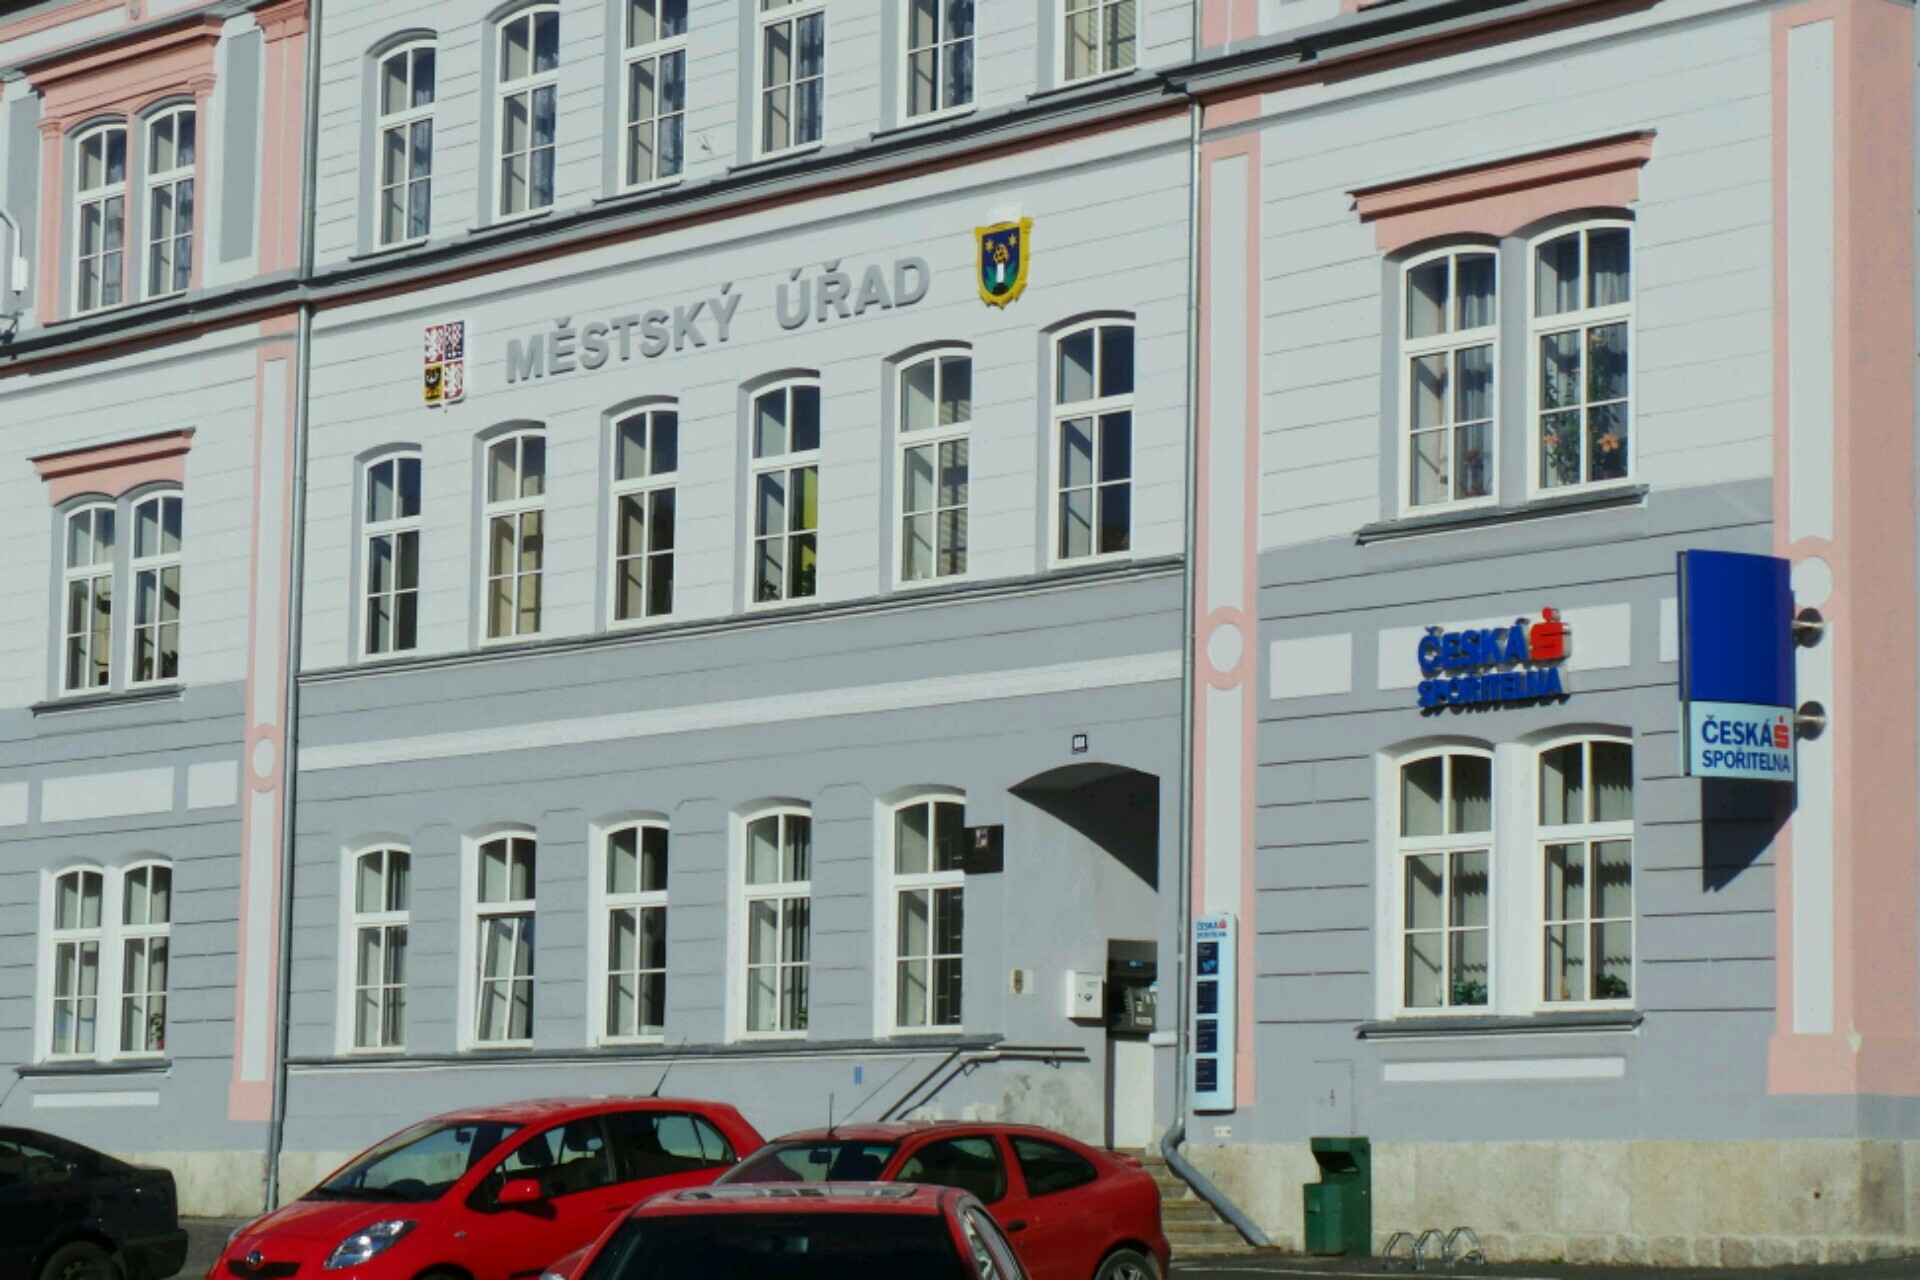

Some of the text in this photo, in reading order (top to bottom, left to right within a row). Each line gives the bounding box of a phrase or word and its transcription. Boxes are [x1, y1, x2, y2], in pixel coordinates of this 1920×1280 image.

[506, 256, 931, 384] MĚSTSKÝ ÚŘAD
[1418, 618, 1529, 671] ČESKÁ
[1702, 714, 1773, 747] ČESKÁ
[1702, 746, 1790, 773] SPOŘITELNA
